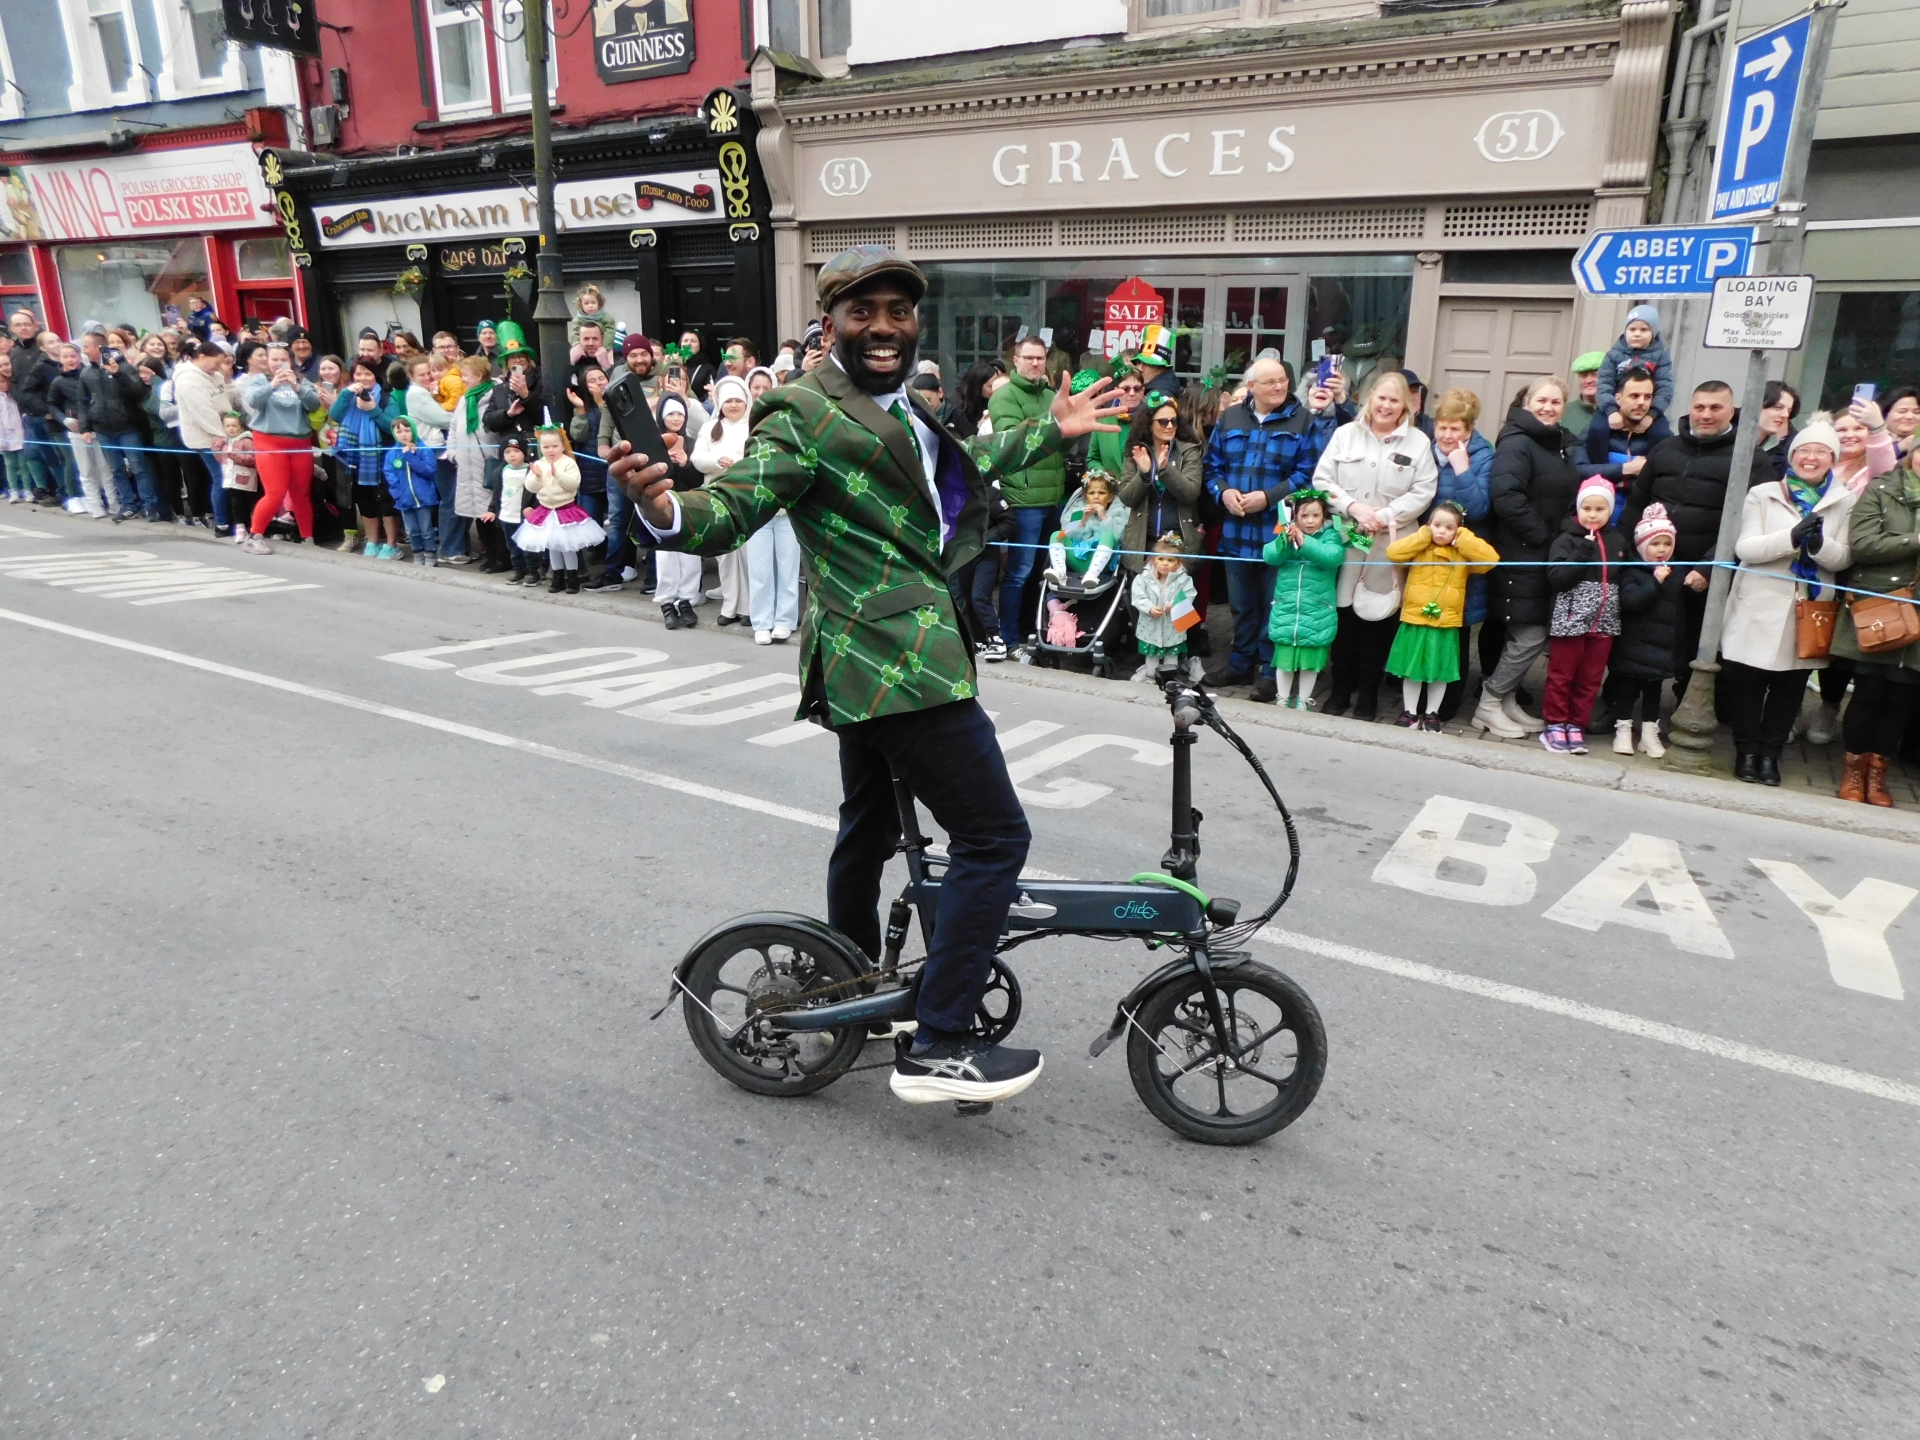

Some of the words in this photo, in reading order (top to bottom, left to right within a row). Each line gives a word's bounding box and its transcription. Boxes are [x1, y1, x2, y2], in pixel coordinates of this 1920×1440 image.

[602, 33, 685, 67] GUINNESS
[1496, 117, 1539, 154] 51
[1733, 90, 1775, 181] P
[992, 125, 1296, 187] GRACES
[121, 179, 159, 196] POLISH
[161, 175, 211, 193] GROCERY
[212, 171, 243, 188] SHOP
[831, 163, 860, 191] 51
[30, 167, 125, 239] NINA
[125, 196, 192, 223] POLSKI
[195, 191, 250, 218] SKLEP
[1715, 190, 1732, 212] PAY
[1728, 187, 1746, 209] AND
[1745, 181, 1779, 207] DISPLAY
[519, 193, 635, 232] huse
[1617, 237, 1695, 258] ABBEY
[1705, 242, 1738, 279] P
[1614, 264, 1692, 285] STREET
[1727, 281, 1798, 293] LOADING
[1109, 304, 1159, 321] SALE
[1723, 311, 1750, 319] Goods
[1744, 295, 1775, 307] BAY
[1744, 319, 1764, 329] Only
[1745, 328, 1782, 337] Duration
[1725, 336, 1739, 344] 30
[1740, 337, 1775, 345] minutes
[1371, 794, 1919, 1001] BAY
